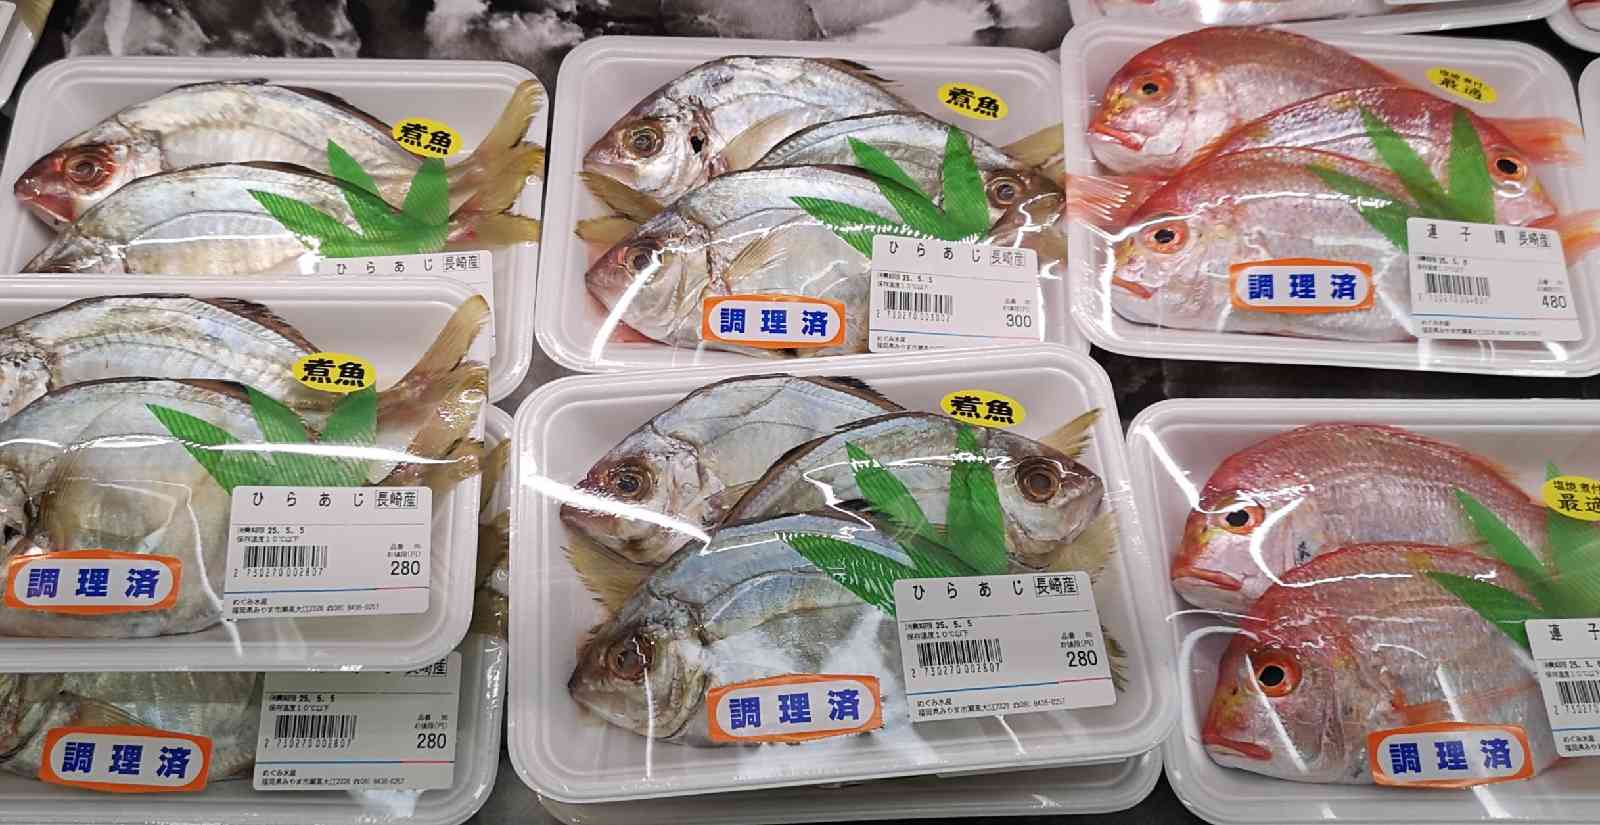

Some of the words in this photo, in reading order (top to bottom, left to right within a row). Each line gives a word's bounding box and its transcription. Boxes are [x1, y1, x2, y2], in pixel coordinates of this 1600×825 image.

[945, 87, 1000, 118] 煮魚
[398, 123, 452, 155] 煮魚
[1519, 230, 1552, 249] 長崎産
[336, 258, 433, 275] ひらあじ
[444, 255, 480, 271] 長崎産
[889, 240, 981, 263] ひらあじ
[990, 249, 1026, 267] 長崎産
[1247, 273, 1357, 301] 調理済
[1541, 295, 1568, 309] 480
[720, 307, 828, 337] 調理済
[1005, 313, 1032, 328] 300
[300, 357, 365, 388] 煮魚
[950, 395, 1015, 424] 煮魚
[252, 491, 365, 508] ひらあじ
[376, 490, 418, 508] 長崎産
[390, 560, 421, 576] 280
[26, 568, 160, 599] 調理済
[912, 579, 1024, 601] ひらあじ
[1036, 576, 1077, 595] 長崎産
[1066, 650, 1098, 667] 280
[729, 689, 860, 730] 調理済
[416, 733, 447, 749] 280
[61, 741, 192, 779] 調理済
[1388, 738, 1513, 775] 調理済
